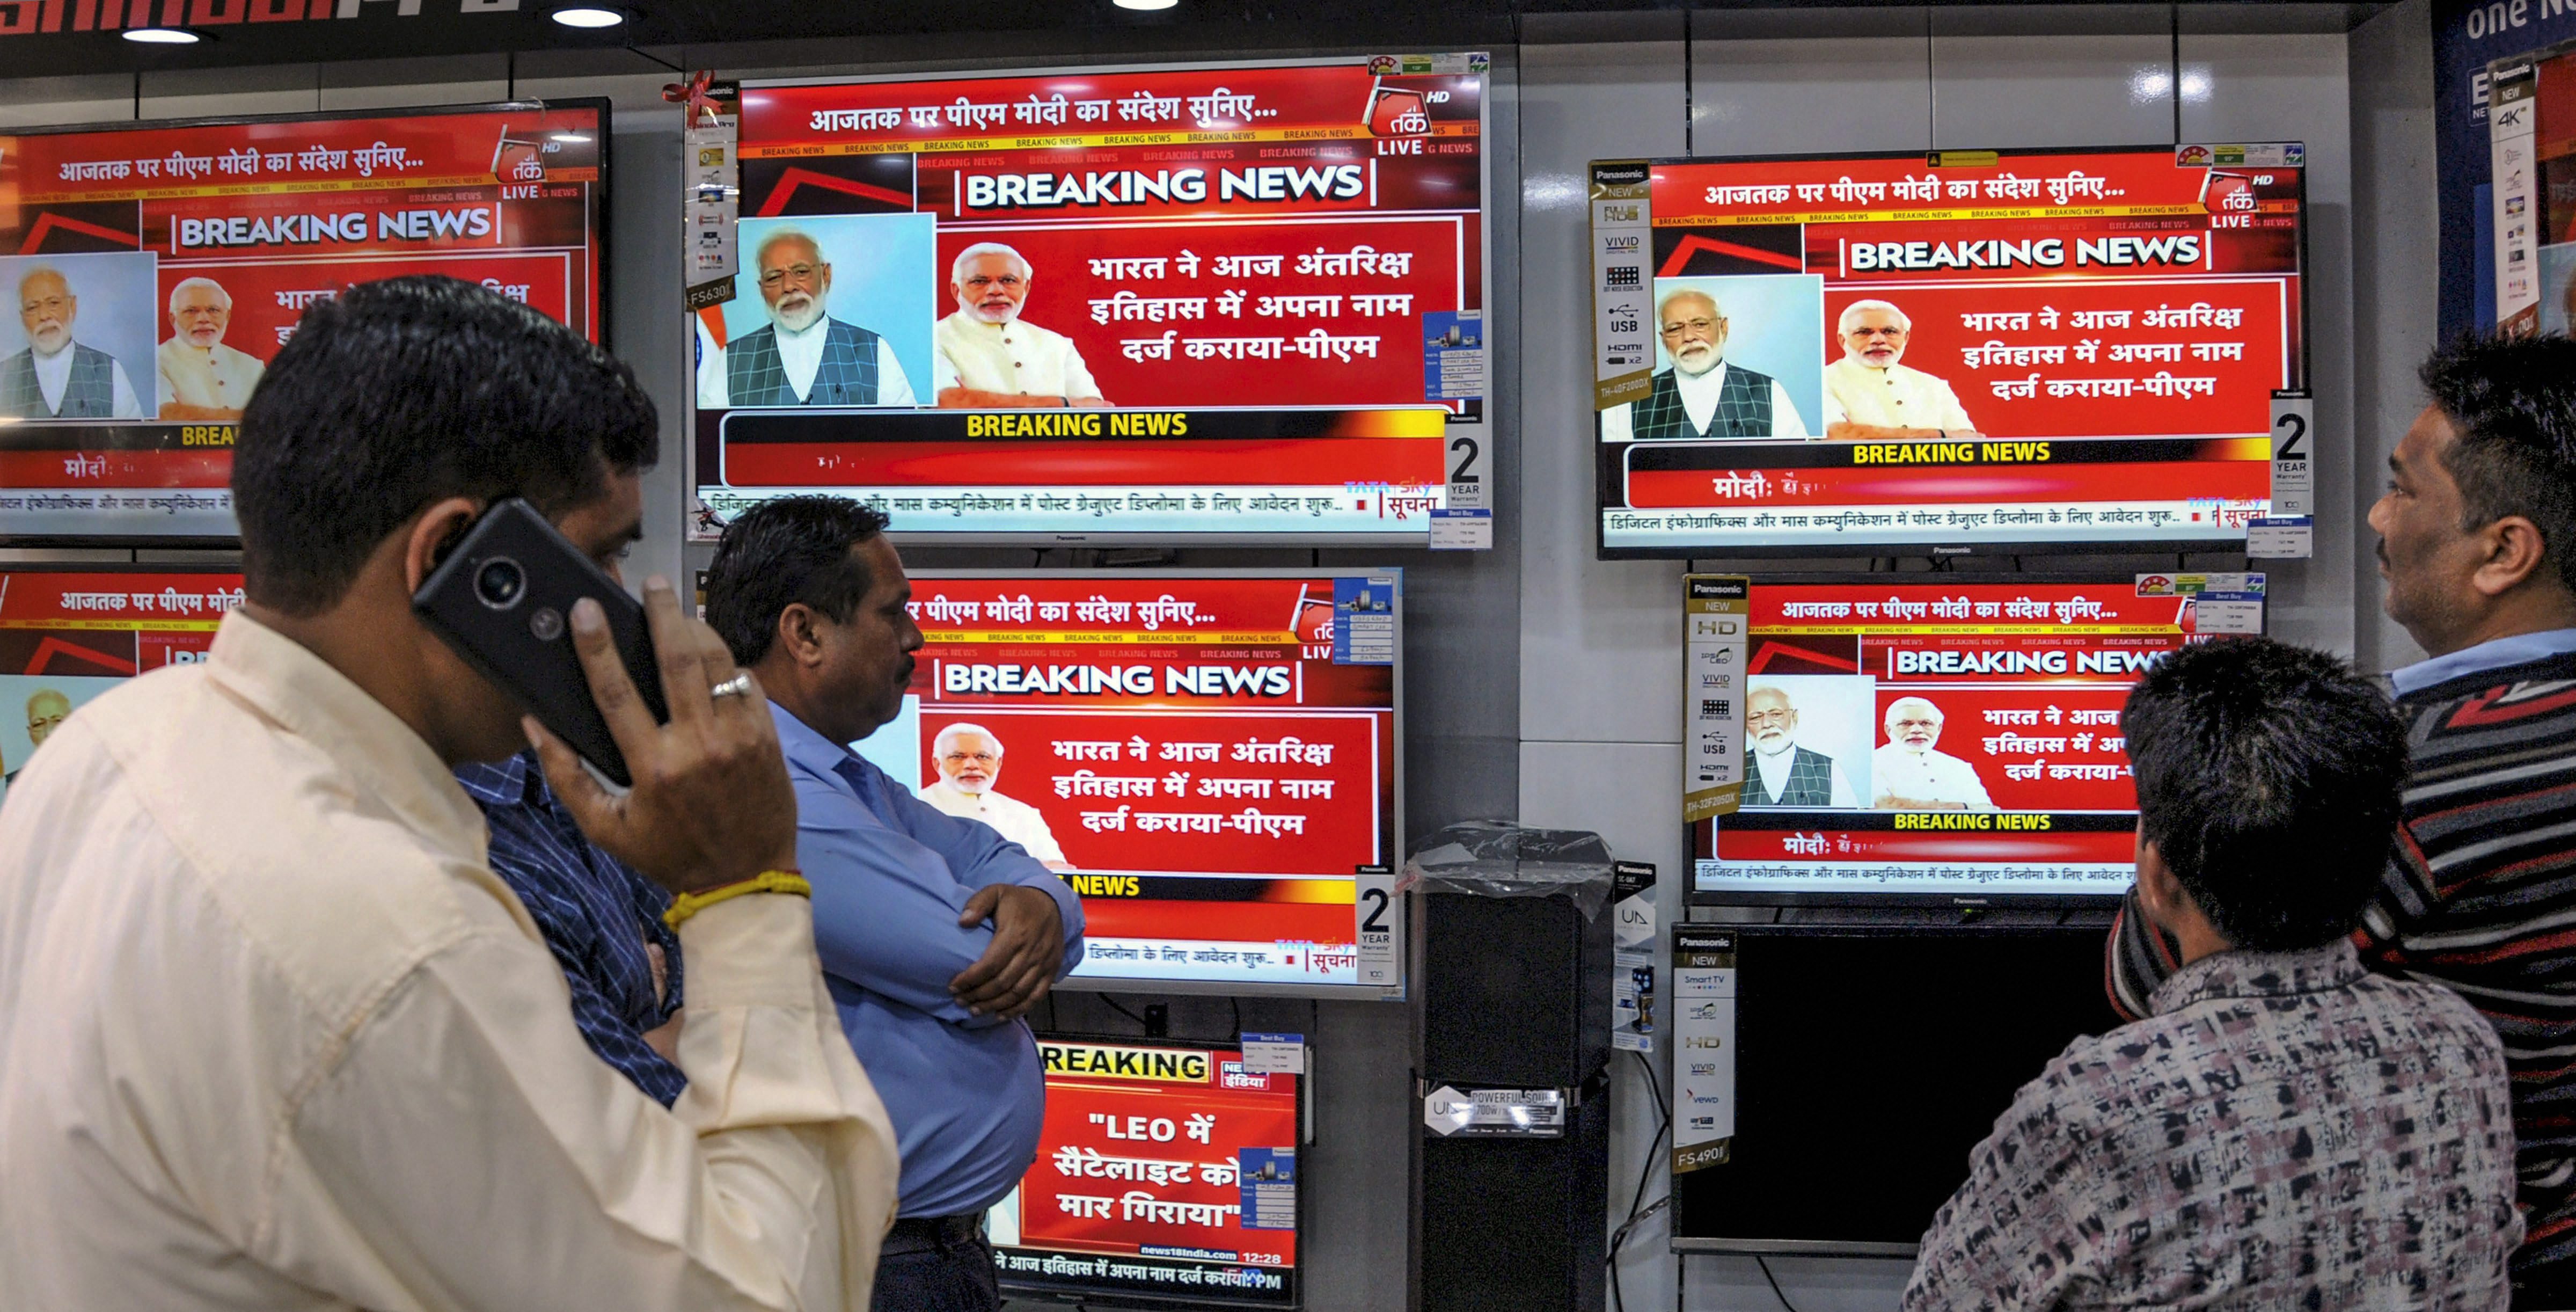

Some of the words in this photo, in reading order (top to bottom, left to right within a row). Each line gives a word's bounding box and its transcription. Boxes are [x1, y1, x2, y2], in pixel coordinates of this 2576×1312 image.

[2493, 64, 2529, 81] Panasonic
[1426, 91, 1450, 103] HD
[2502, 87, 2520, 101] NEW
[810, 108, 902, 131] आजतक
[909, 107, 940, 128] पर
[945, 97, 1008, 130] पीएम
[1013, 93, 1069, 125] मोदी
[1074, 100, 1111, 121] का
[1117, 91, 1181, 121] संदेश
[2498, 109, 2520, 126] 4K
[542, 142, 561, 152] HD
[924, 141, 963, 150] BREAKING
[967, 141, 990, 149] NEWS
[1378, 140, 1422, 155] LIVE
[60, 161, 131, 181] आजतक
[136, 157, 160, 178] पर
[164, 151, 213, 179] पीएम
[217, 147, 260, 175] मोदी
[298, 145, 348, 171] संदेश
[1597, 170, 1643, 179] Panasonic
[2253, 176, 2273, 185] HD
[503, 186, 538, 199] LIVE
[968, 168, 1205, 207] BREAKING
[1220, 165, 1363, 201] NEWS
[1608, 187, 1633, 197] NEW
[1705, 185, 1791, 205] आजतक
[1796, 184, 1825, 202] पर
[1829, 177, 1886, 205] पीएम
[1891, 174, 1941, 201] मोदी
[1946, 180, 1979, 199] का
[1984, 173, 2040, 199] संदेश
[180, 211, 367, 249] BREAKING
[377, 208, 491, 241] NEWS
[2212, 215, 2250, 228] LIVE
[1606, 237, 1638, 246] VIVID
[1088, 258, 1168, 279] भारत
[1176, 250, 1201, 278] ने
[1212, 256, 1284, 277] आज
[1295, 245, 1413, 278] अंतरिक्ष
[1851, 239, 2064, 269] BREAKING
[2076, 236, 2200, 265] NEWS
[1088, 291, 1208, 325] इतिहास
[1215, 289, 1247, 318] में
[1255, 295, 1342, 318] अपना
[1350, 295, 1413, 316] नाम
[1612, 321, 1637, 332] USB
[1961, 313, 2031, 331] भारत
[2038, 306, 2060, 330] ने
[2070, 311, 2133, 329] आज
[2142, 303, 2243, 329] अंतरिक्ष
[1121, 331, 1177, 363] दर्ज
[1182, 329, 1380, 363] कराया-पीएम
[1961, 340, 2067, 369] इतिहास
[2073, 339, 2101, 363] में
[2109, 344, 2183, 362] अपना
[2190, 343, 2244, 361] नाम
[1990, 373, 2040, 400] दर्ज
[2045, 371, 2216, 399] कराया-पीएम
[968, 414, 1100, 436] BREAKING
[1111, 413, 1187, 435] NEWS
[2277, 414, 2306, 460] 2
[1451, 438, 1479, 483] 2
[1854, 444, 1973, 463] BREAKING
[1982, 442, 2050, 461] NEWS
[2277, 463, 2306, 471] YEAR
[1344, 483, 1389, 493] TATA
[1452, 485, 1479, 494] YEAR
[1037, 493, 1071, 510] पोस्ट
[1212, 493, 1242, 511] लिए
[1249, 493, 1300, 511] आवेदन
[1388, 497, 1437, 520] सूचना
[1610, 514, 1660, 531] डिजिटल
[1753, 513, 1776, 527] और
[1781, 516, 1807, 527] मास
[1897, 511, 1908, 525] में
[1912, 511, 1942, 524] पोस्ट
[2048, 509, 2061, 523] के
[2067, 508, 2092, 525] लिए
[2099, 511, 2143, 523] आवेदन
[1695, 585, 1741, 593] Panasonic
[61, 593, 128, 610] आजतक
[131, 594, 155, 610] पर
[157, 587, 203, 615] पीएम
[1706, 602, 1730, 611] NEW
[1782, 603, 1851, 617] आजतक
[1882, 597, 1928, 621] पीएम
[1931, 596, 1971, 618] मोदी
[2004, 597, 2051, 618] संदेश
[1698, 621, 1736, 635] HD
[1898, 651, 2067, 675] BREAKING
[946, 665, 1153, 695] BREAKING
[1167, 666, 1290, 695] NEWS
[1051, 741, 1121, 760] भारत
[1231, 737, 1334, 766] अंतरिक्ष
[1704, 745, 1725, 754] USB
[1982, 732, 2067, 755] इतिहास
[1134, 808, 1306, 838] कराया-पीएम
[1895, 814, 1989, 829] BREAKING
[1997, 815, 2050, 829] NEWS
[1619, 865, 1652, 874] Panasonic
[1073, 876, 1139, 895] NEWS
[1362, 888, 1389, 932] 2
[1363, 935, 1389, 943] YEAR
[1680, 938, 1729, 946] Panasonic
[1313, 954, 1356, 973] सूचना
[1693, 957, 1716, 965] NEW
[1687, 1037, 1720, 1048] HD
[1042, 1047, 1205, 1079] REAKING
[1225, 1074, 1265, 1087] इंडिया
[1473, 1092, 1523, 1103] POWERFUL
[1089, 1113, 1175, 1142] "LEO
[1184, 1113, 1215, 1143] में
[1052, 1146, 1193, 1186] सैटेलाइट
[1056, 1194, 1114, 1219] मार
[995, 1251, 1007, 1269] ने
[1009, 1256, 1040, 1271] आज
[1042, 1257, 1093, 1278] इतिहास
[1094, 1259, 1108, 1276] में
[1110, 1264, 1148, 1279] अपना
[1149, 1267, 1176, 1281] नाम
[1177, 1266, 1203, 1284] दर्ज
[1242, 1252, 1281, 1264] 12:28
